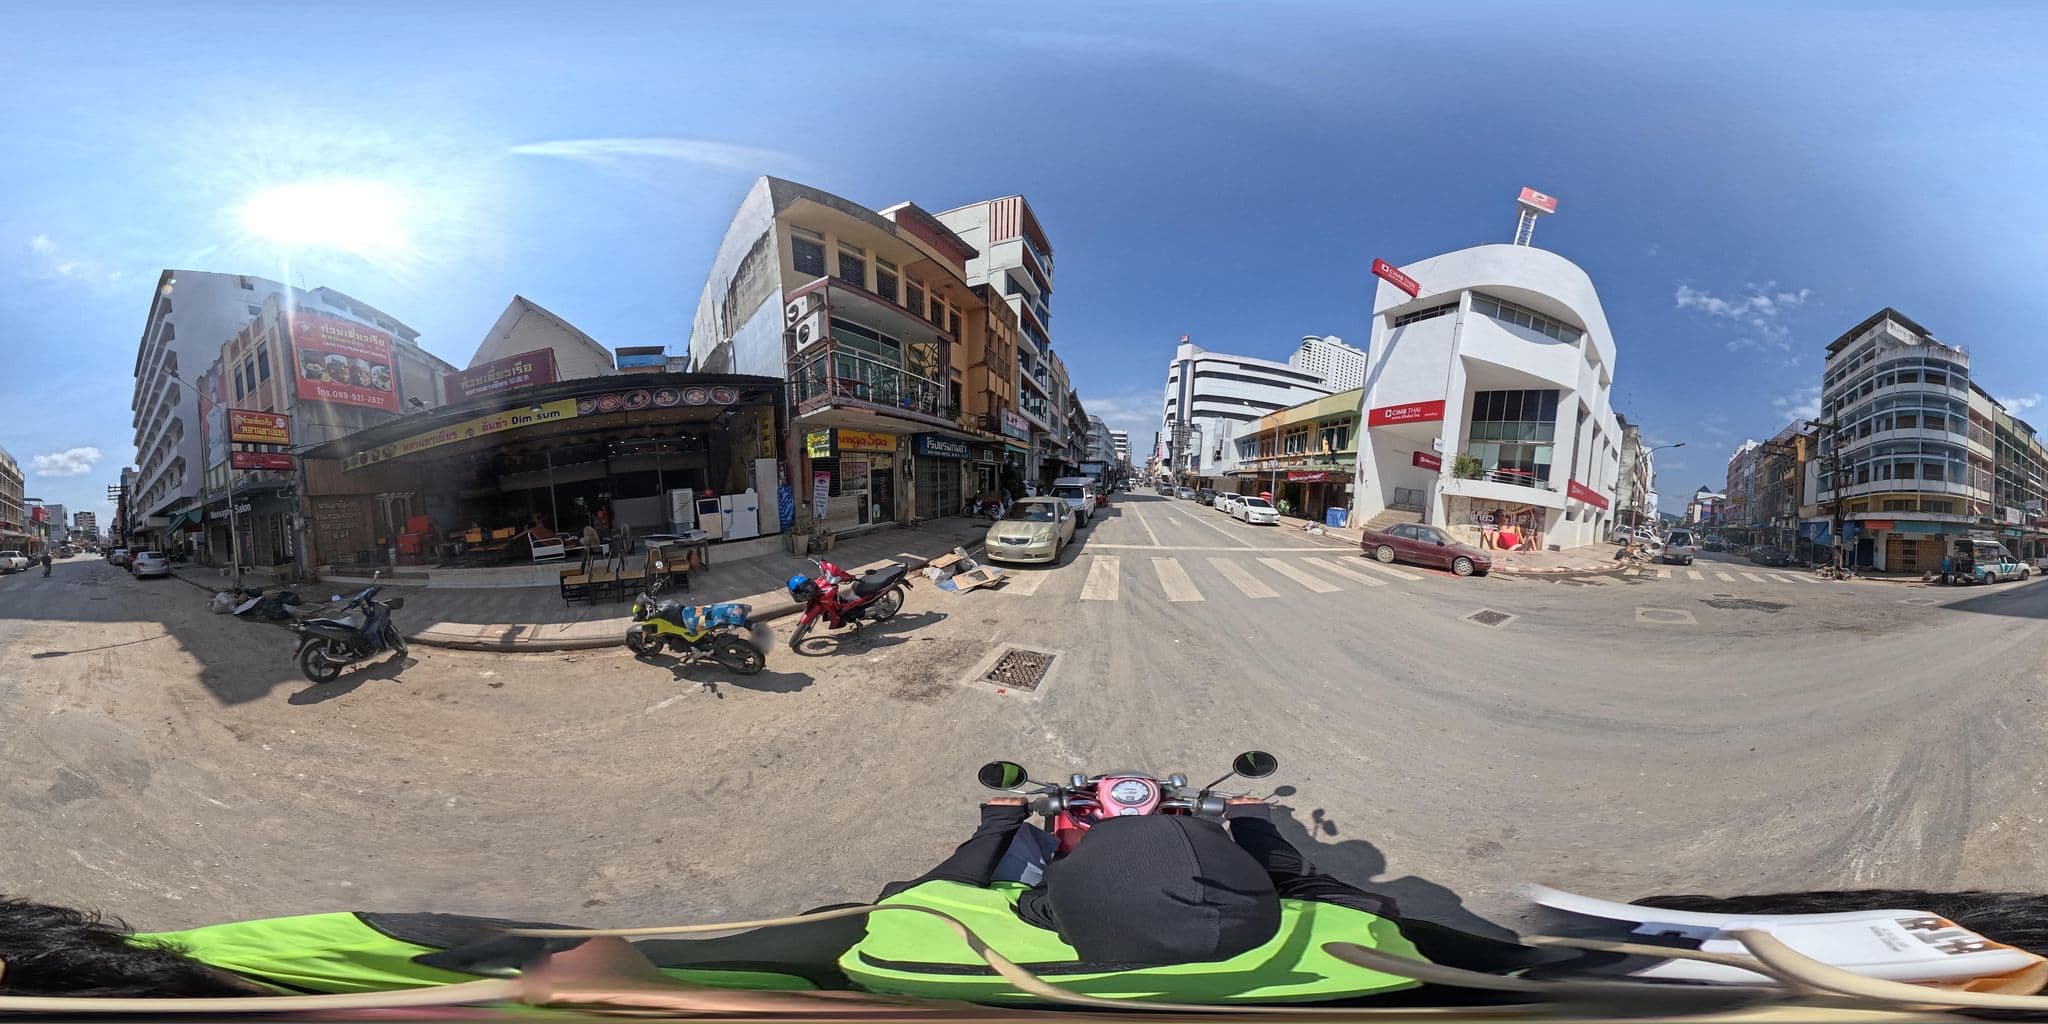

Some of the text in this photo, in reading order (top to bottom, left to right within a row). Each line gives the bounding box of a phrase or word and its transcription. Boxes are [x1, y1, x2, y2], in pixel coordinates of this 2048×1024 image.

[511, 414, 532, 425] Dim
[536, 409, 561, 421] sum
[1392, 408, 1407, 416] CIMB
[1407, 406, 1421, 414] THAI
[867, 433, 888, 447] Spa
[234, 503, 252, 514] Salon
